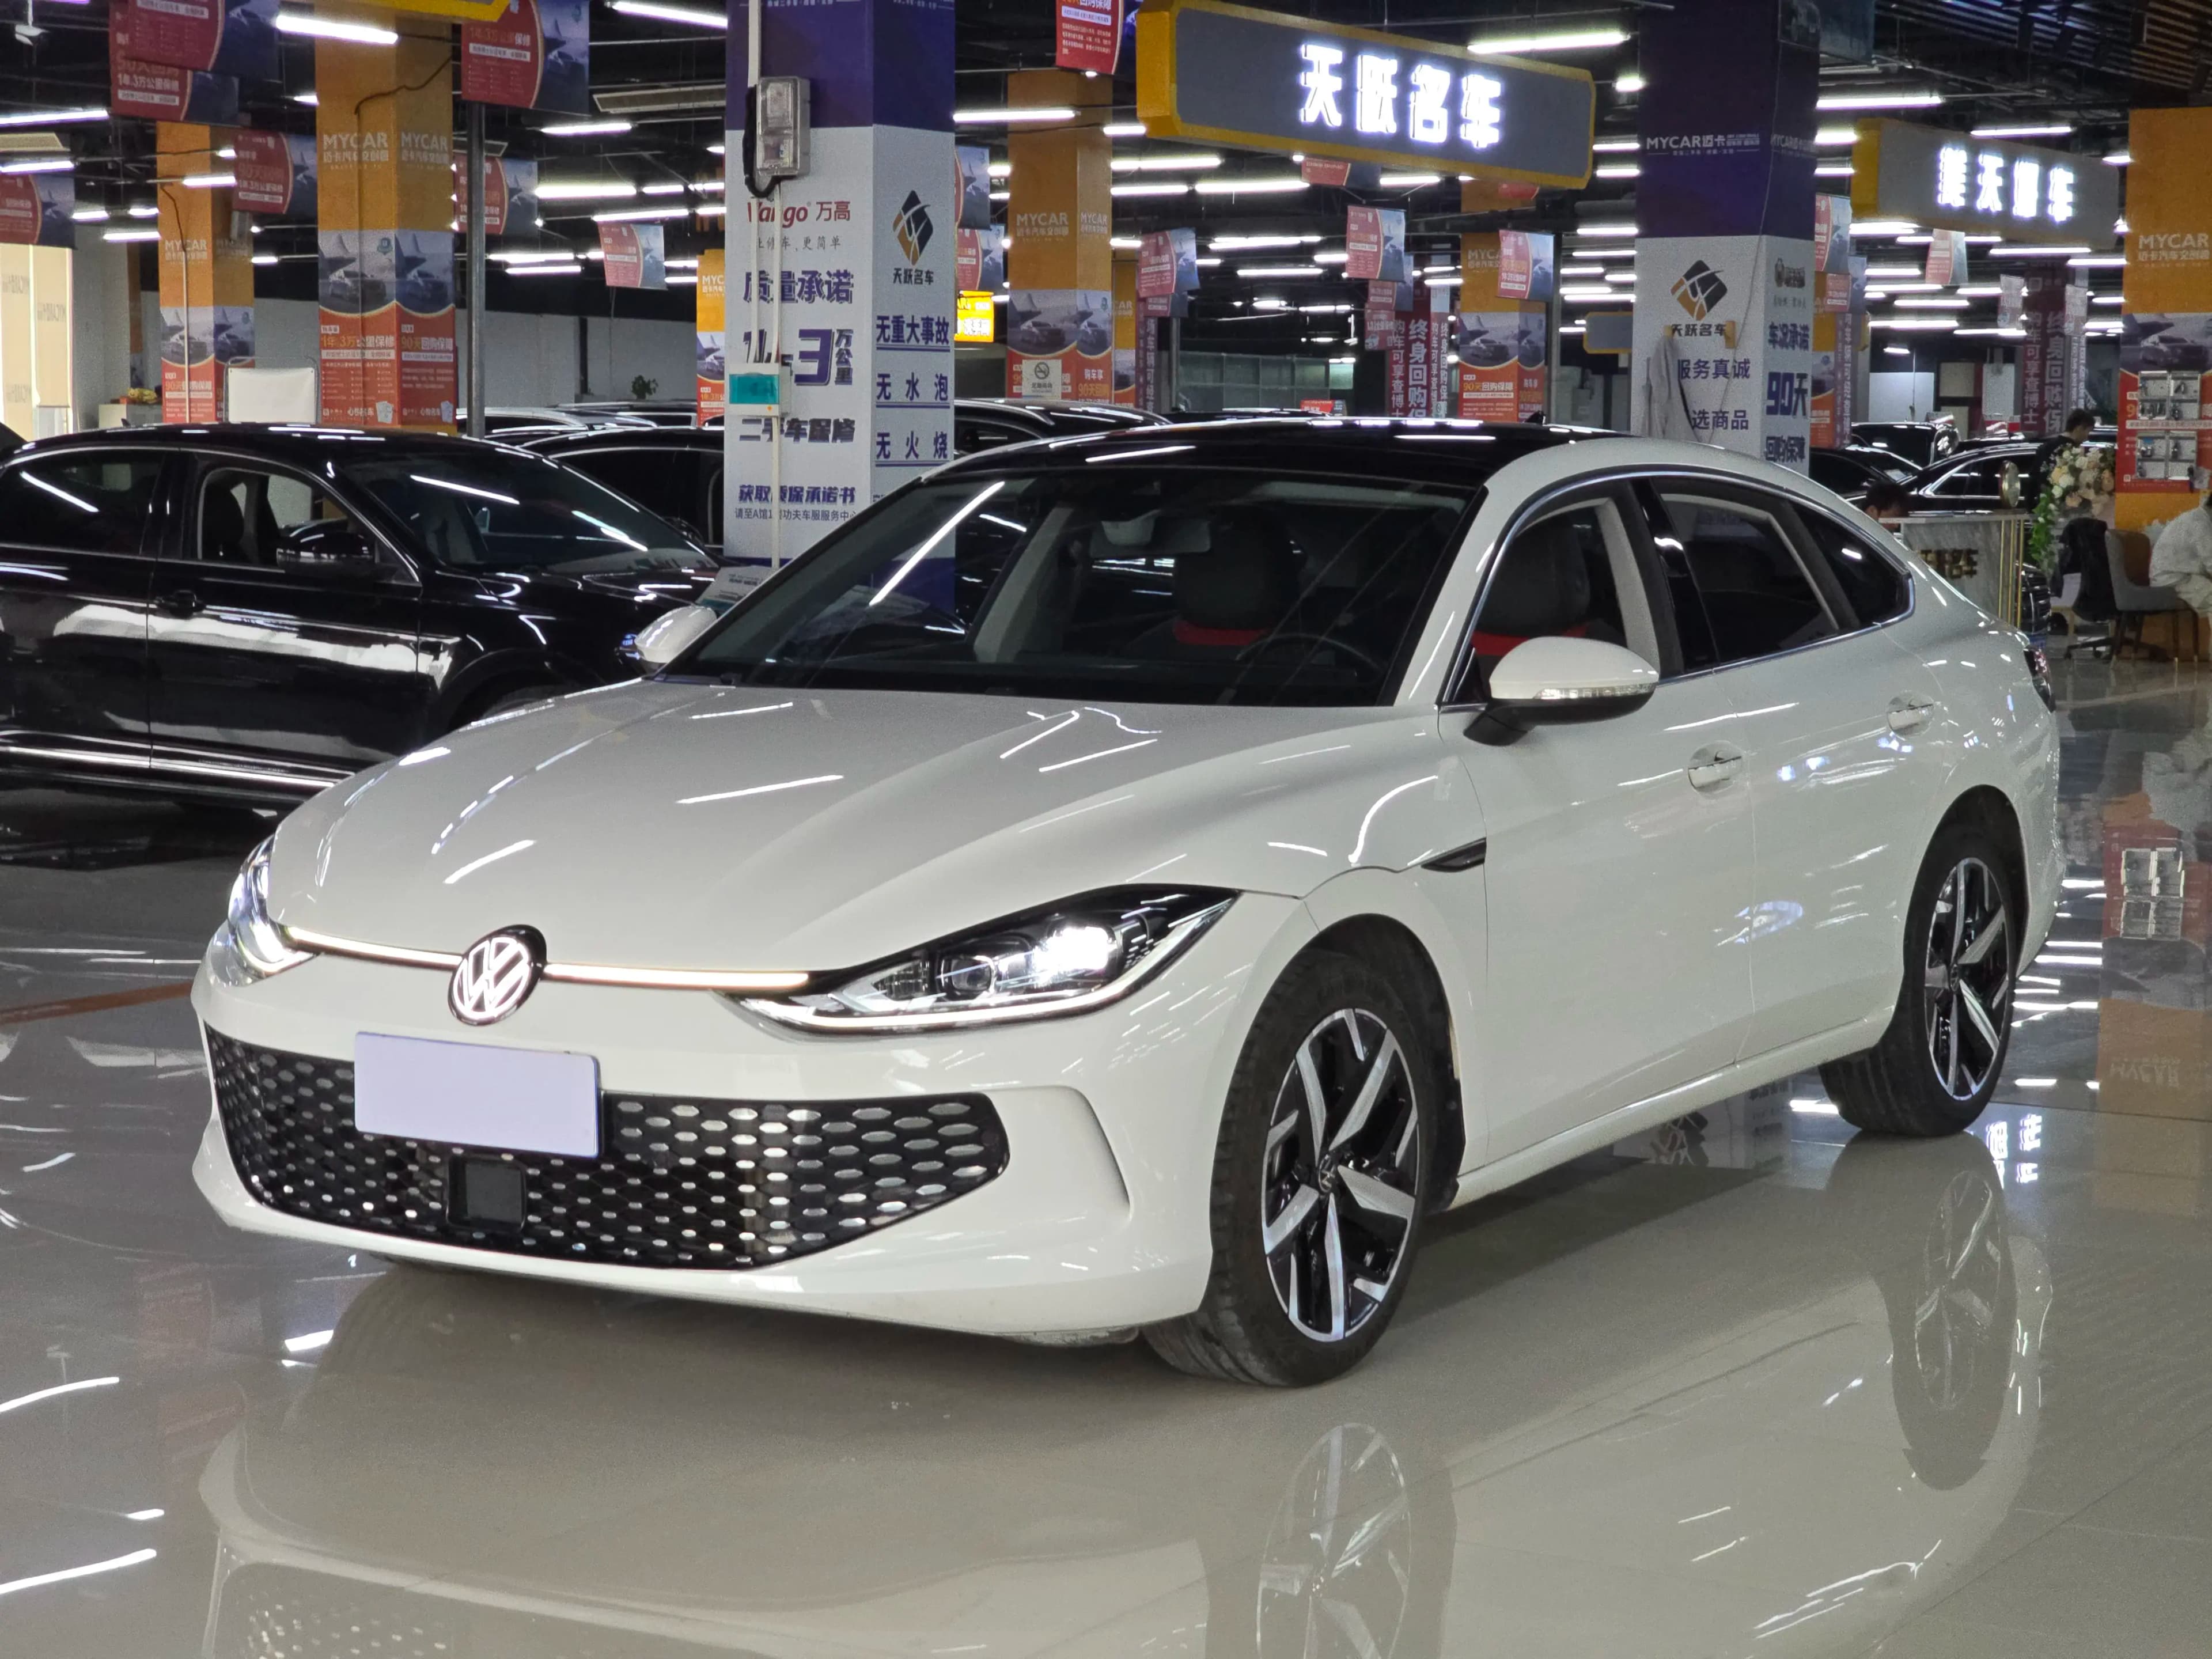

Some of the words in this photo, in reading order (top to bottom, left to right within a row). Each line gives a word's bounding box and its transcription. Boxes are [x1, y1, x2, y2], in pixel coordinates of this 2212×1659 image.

[1301, 44, 1501, 149] 天跃名车
[323, 132, 388, 149] MYCAR
[401, 131, 448, 151] MYCAR
[747, 202, 808, 228] Vago
[816, 201, 851, 221] 万高
[1016, 212, 1069, 226] MYCAR
[1081, 211, 1107, 225] MYCAR
[165, 239, 207, 251] MYCAR
[2139, 233, 2209, 249] MYCAR
[743, 269, 854, 304] 质量承诺
[893, 267, 934, 286] 天跃名车
[876, 315, 949, 344] 无重大事故
[1672, 323, 1726, 337] 天跃名车
[1677, 358, 1751, 379] 服务真诚
[876, 372, 949, 401] 无水泡
[1766, 372, 1808, 418] 90天
[876, 431, 948, 459] 无火烧
[735, 507, 857, 522] 请至A馆1功夫车服服务中心
